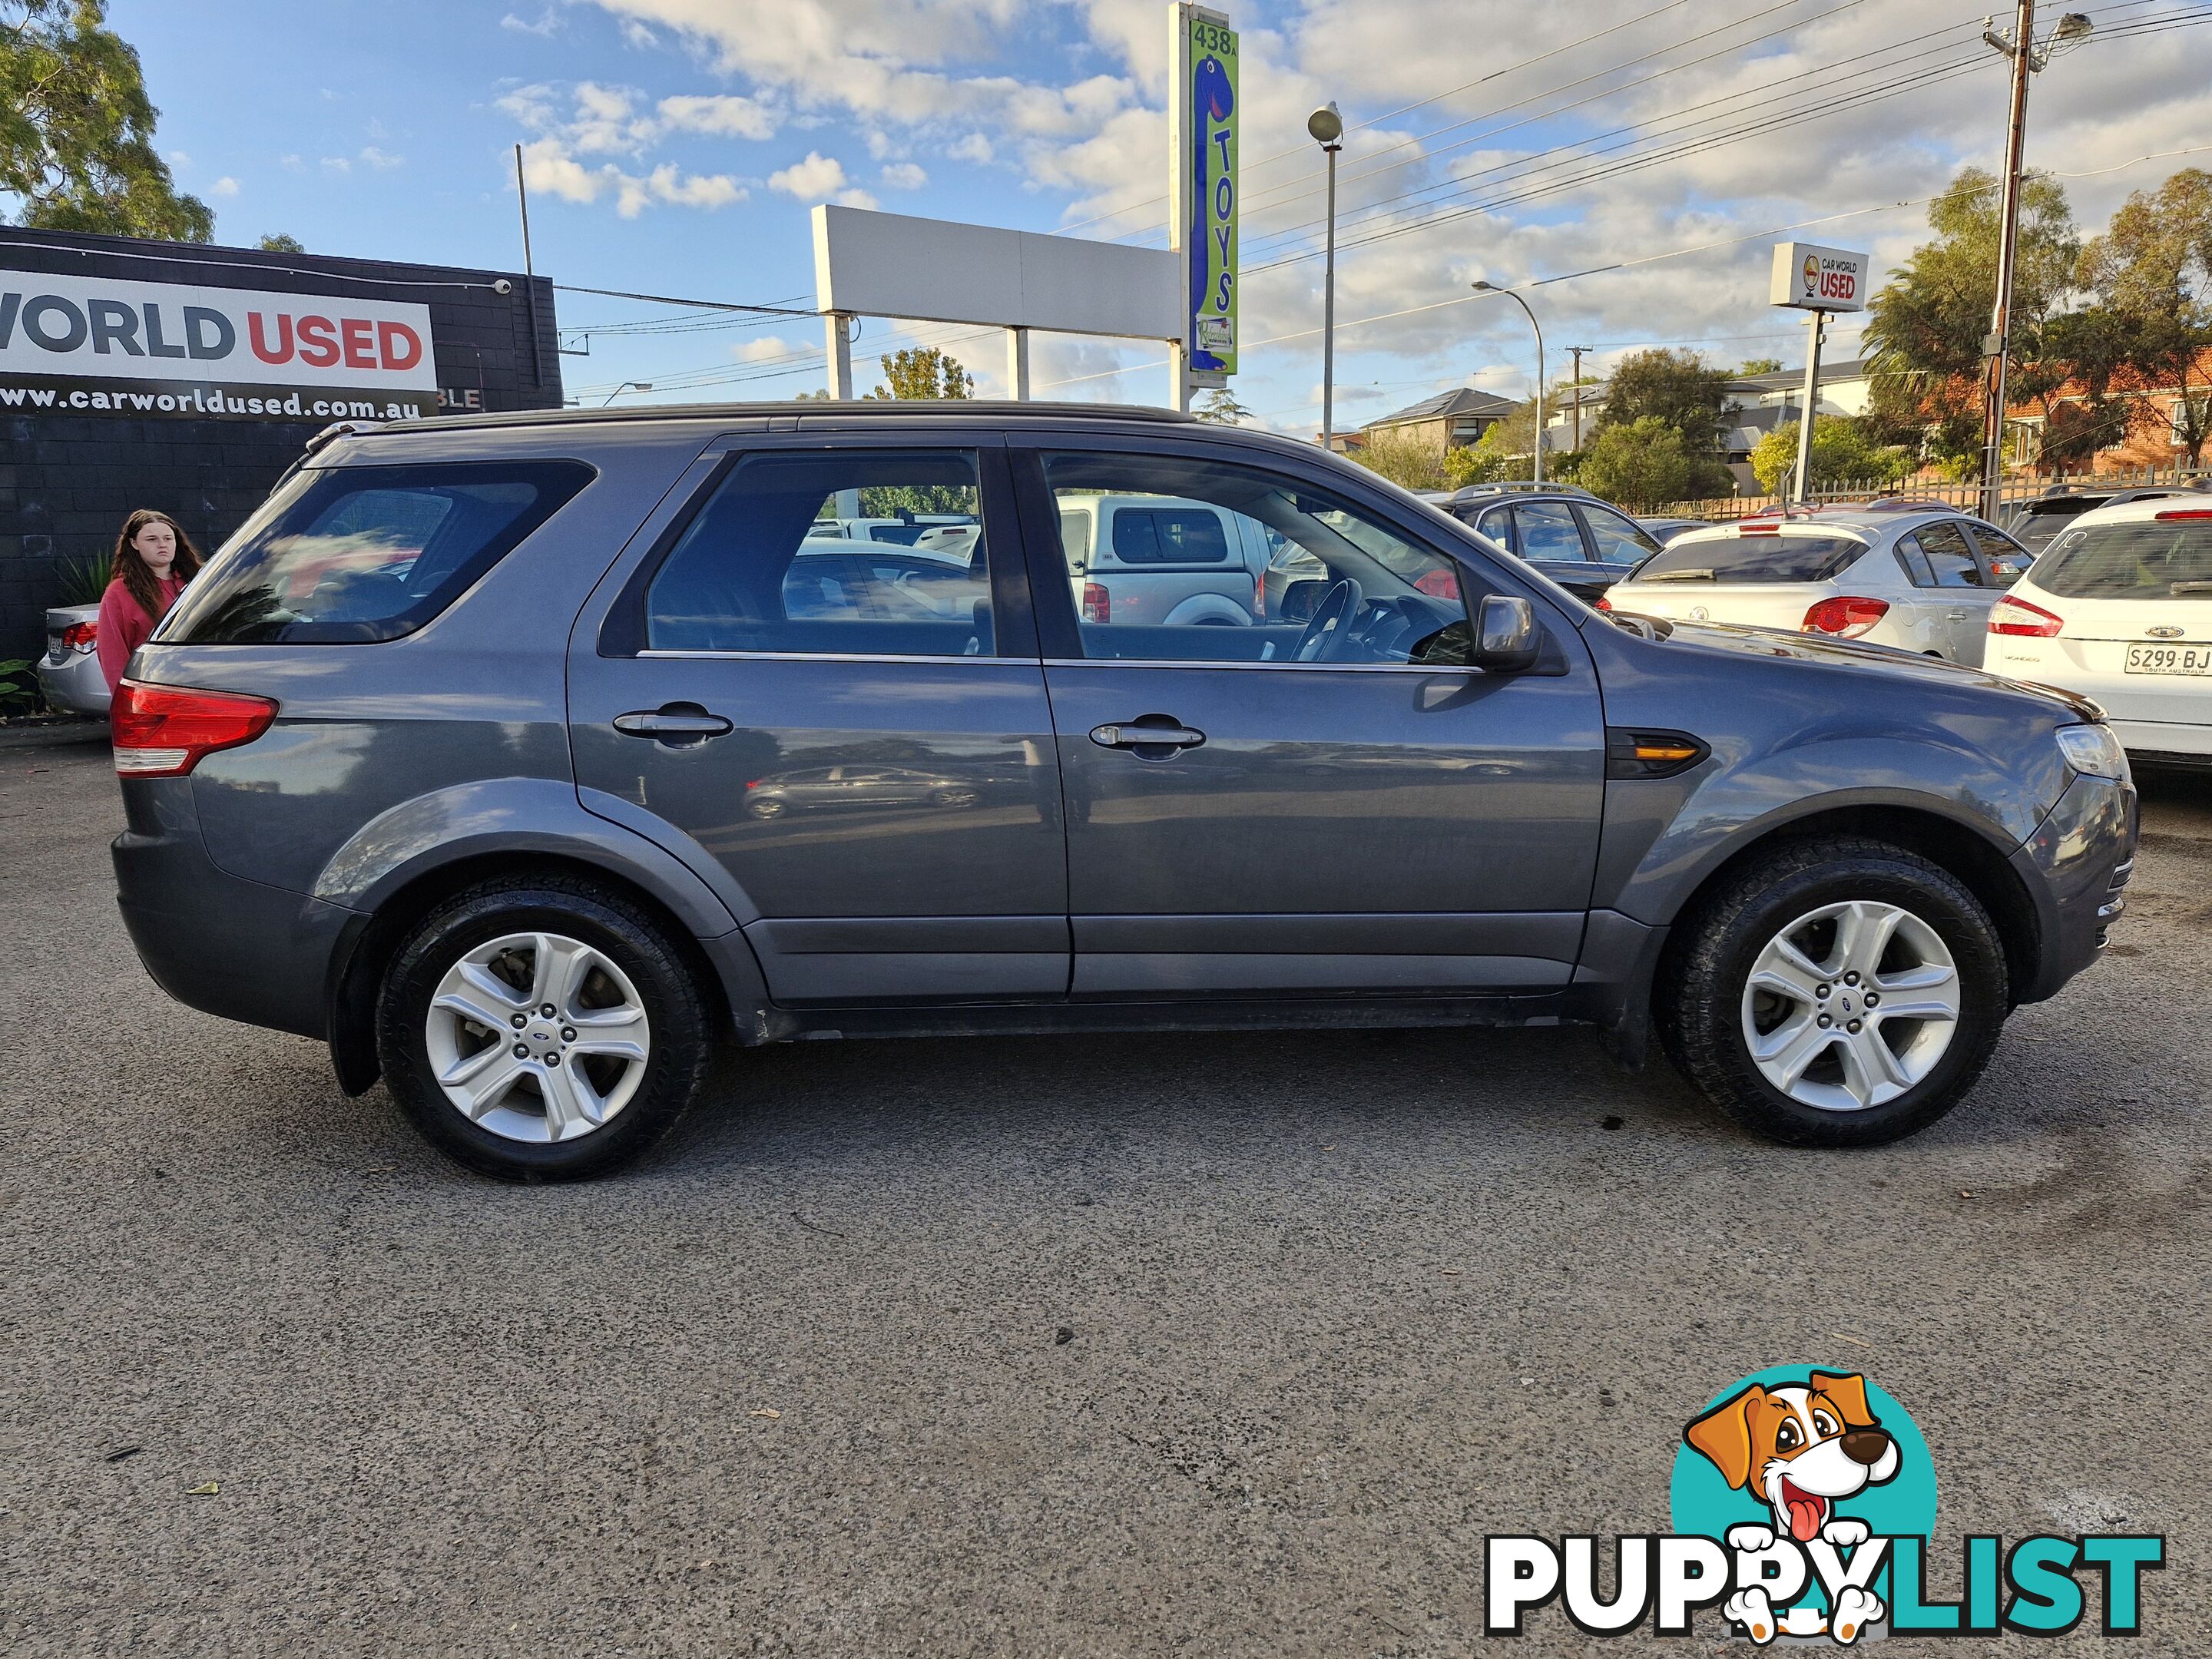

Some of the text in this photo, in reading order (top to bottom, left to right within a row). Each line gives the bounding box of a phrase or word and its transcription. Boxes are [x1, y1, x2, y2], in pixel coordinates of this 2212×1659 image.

[1214, 129, 1232, 312] TOYS
[1820, 272, 1855, 299] USED
[1823, 258, 1857, 273] CAR WORLD
[247, 312, 422, 370] USED
